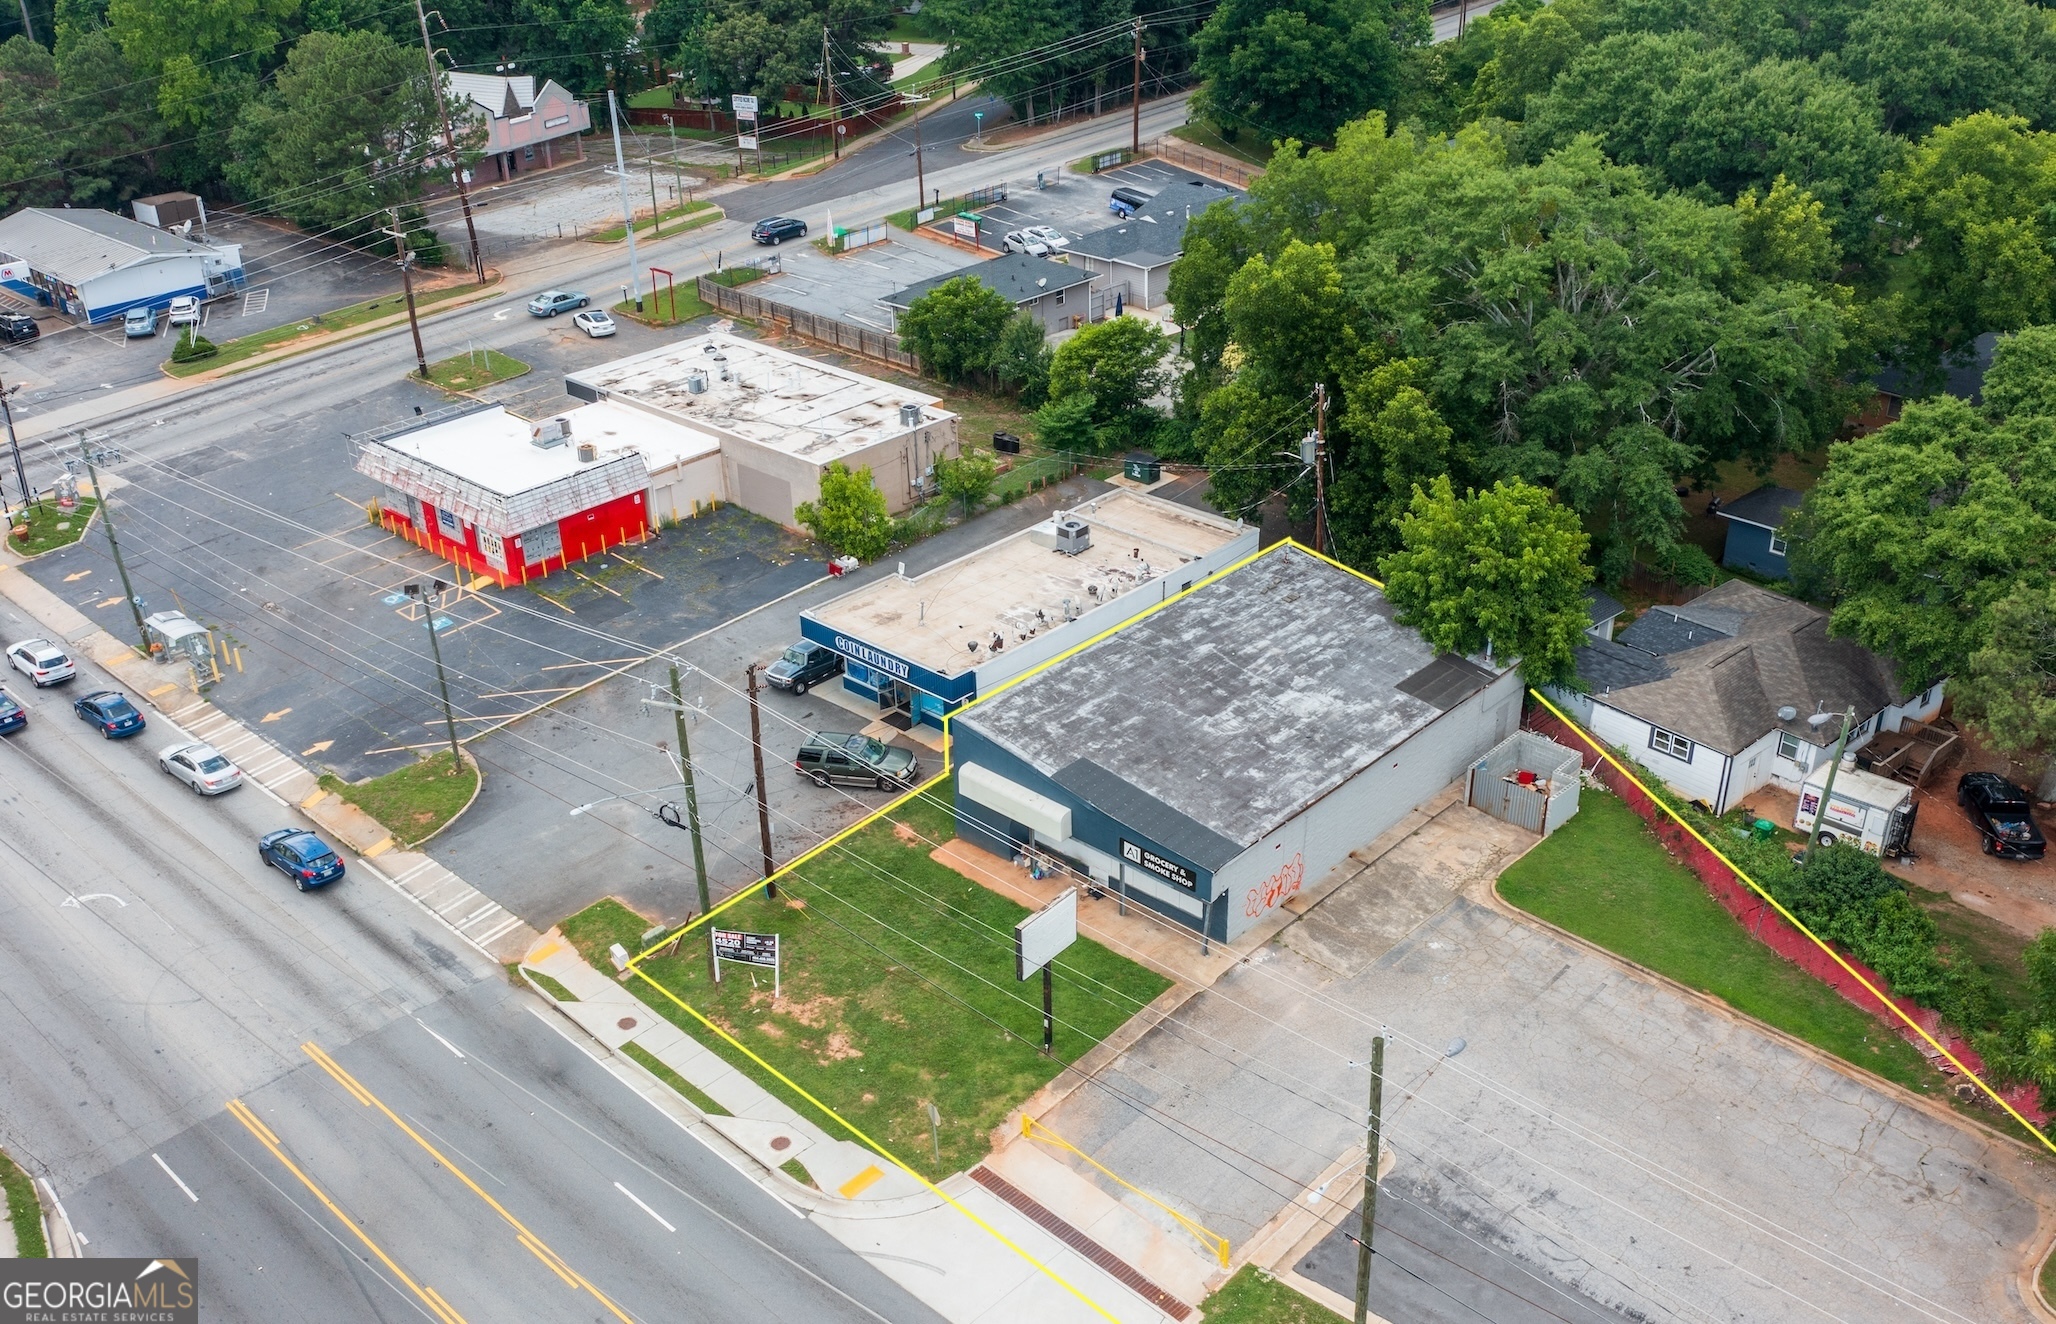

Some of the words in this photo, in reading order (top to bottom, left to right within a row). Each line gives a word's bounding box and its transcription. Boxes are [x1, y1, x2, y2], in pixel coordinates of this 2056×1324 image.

[837, 637, 861, 656] COIN
[862, 648, 907, 676] LAUNDRY
[1126, 846, 1139, 860] A1
[1144, 852, 1179, 872] GROCERY
[1180, 868, 1187, 877] &
[1144, 860, 1171, 877] SMOKE
[1171, 873, 1193, 887] SHOP
